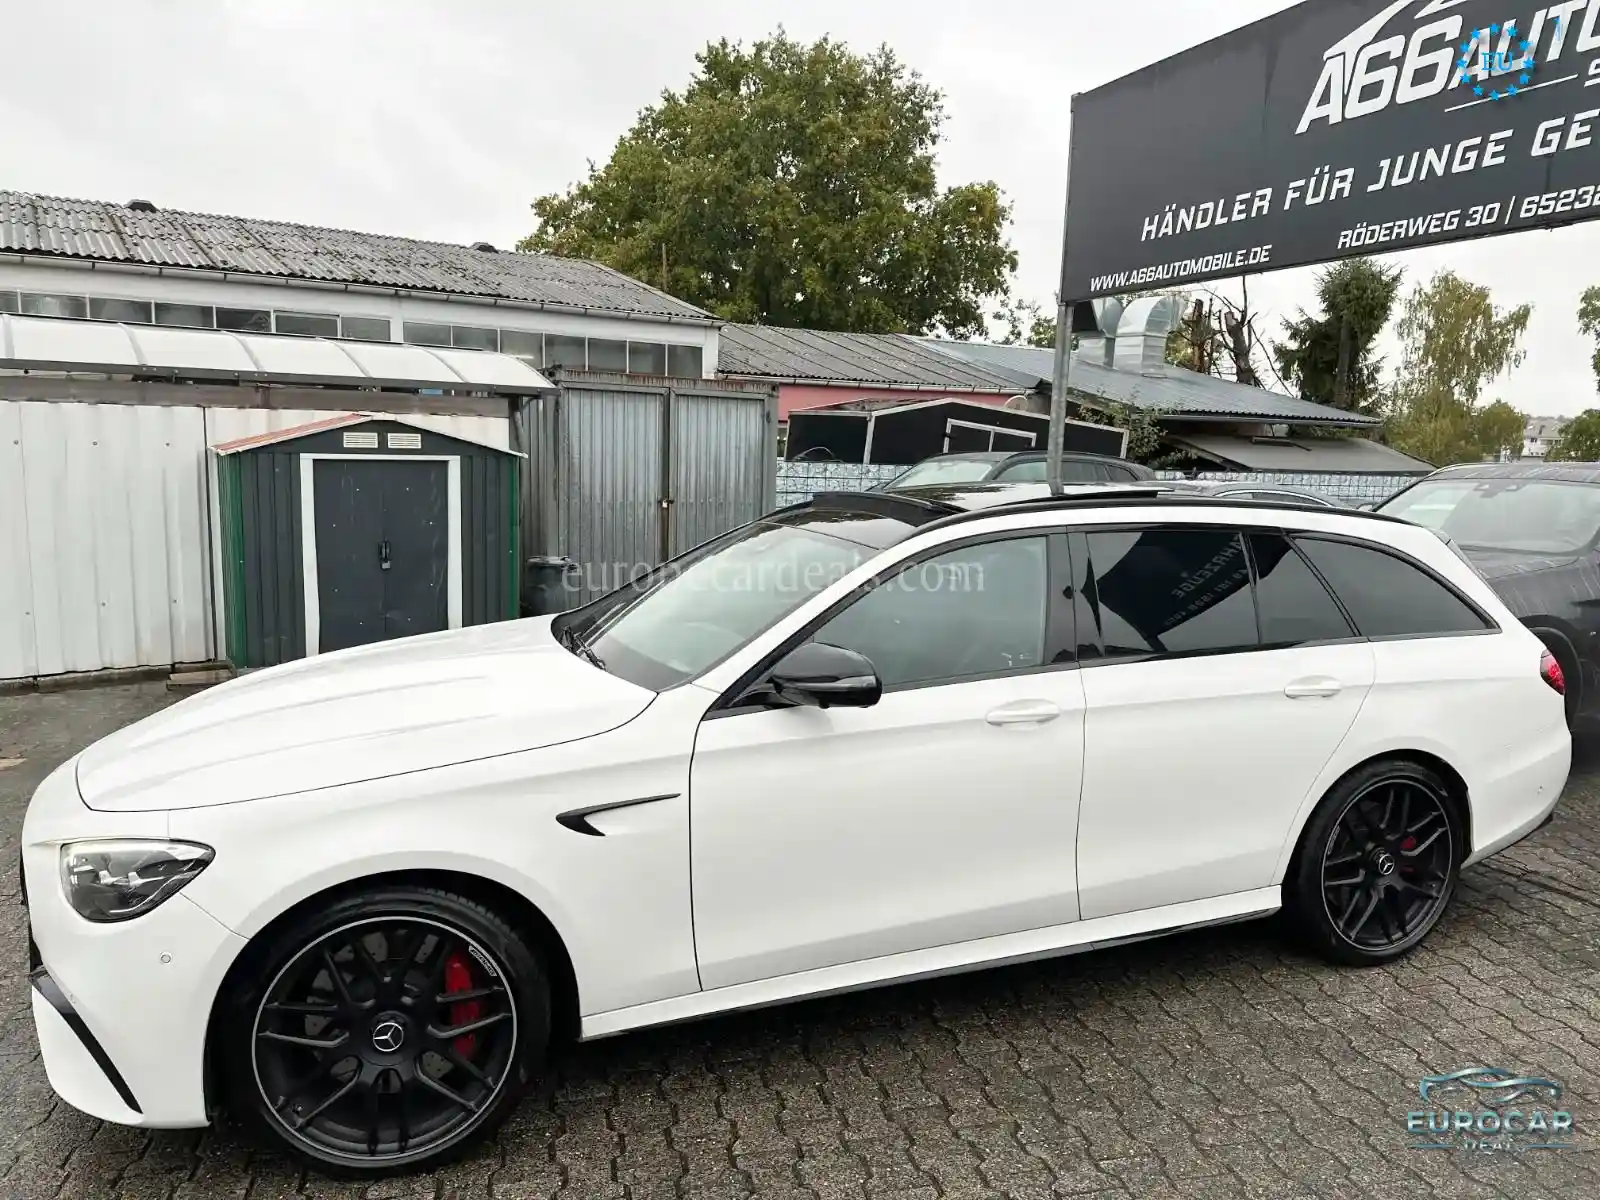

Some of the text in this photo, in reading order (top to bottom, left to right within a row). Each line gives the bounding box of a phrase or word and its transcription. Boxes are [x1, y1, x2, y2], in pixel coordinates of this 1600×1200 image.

[1141, 187, 1272, 242] HÄNDLER
[1283, 164, 1355, 211] FÜR
[1367, 129, 1514, 193] JUNGE
[1337, 209, 1461, 249] RÖDERWEG
[1465, 202, 1501, 228] 30
[1090, 244, 1272, 292] WWW.A66AUTOMOBILE.DE
